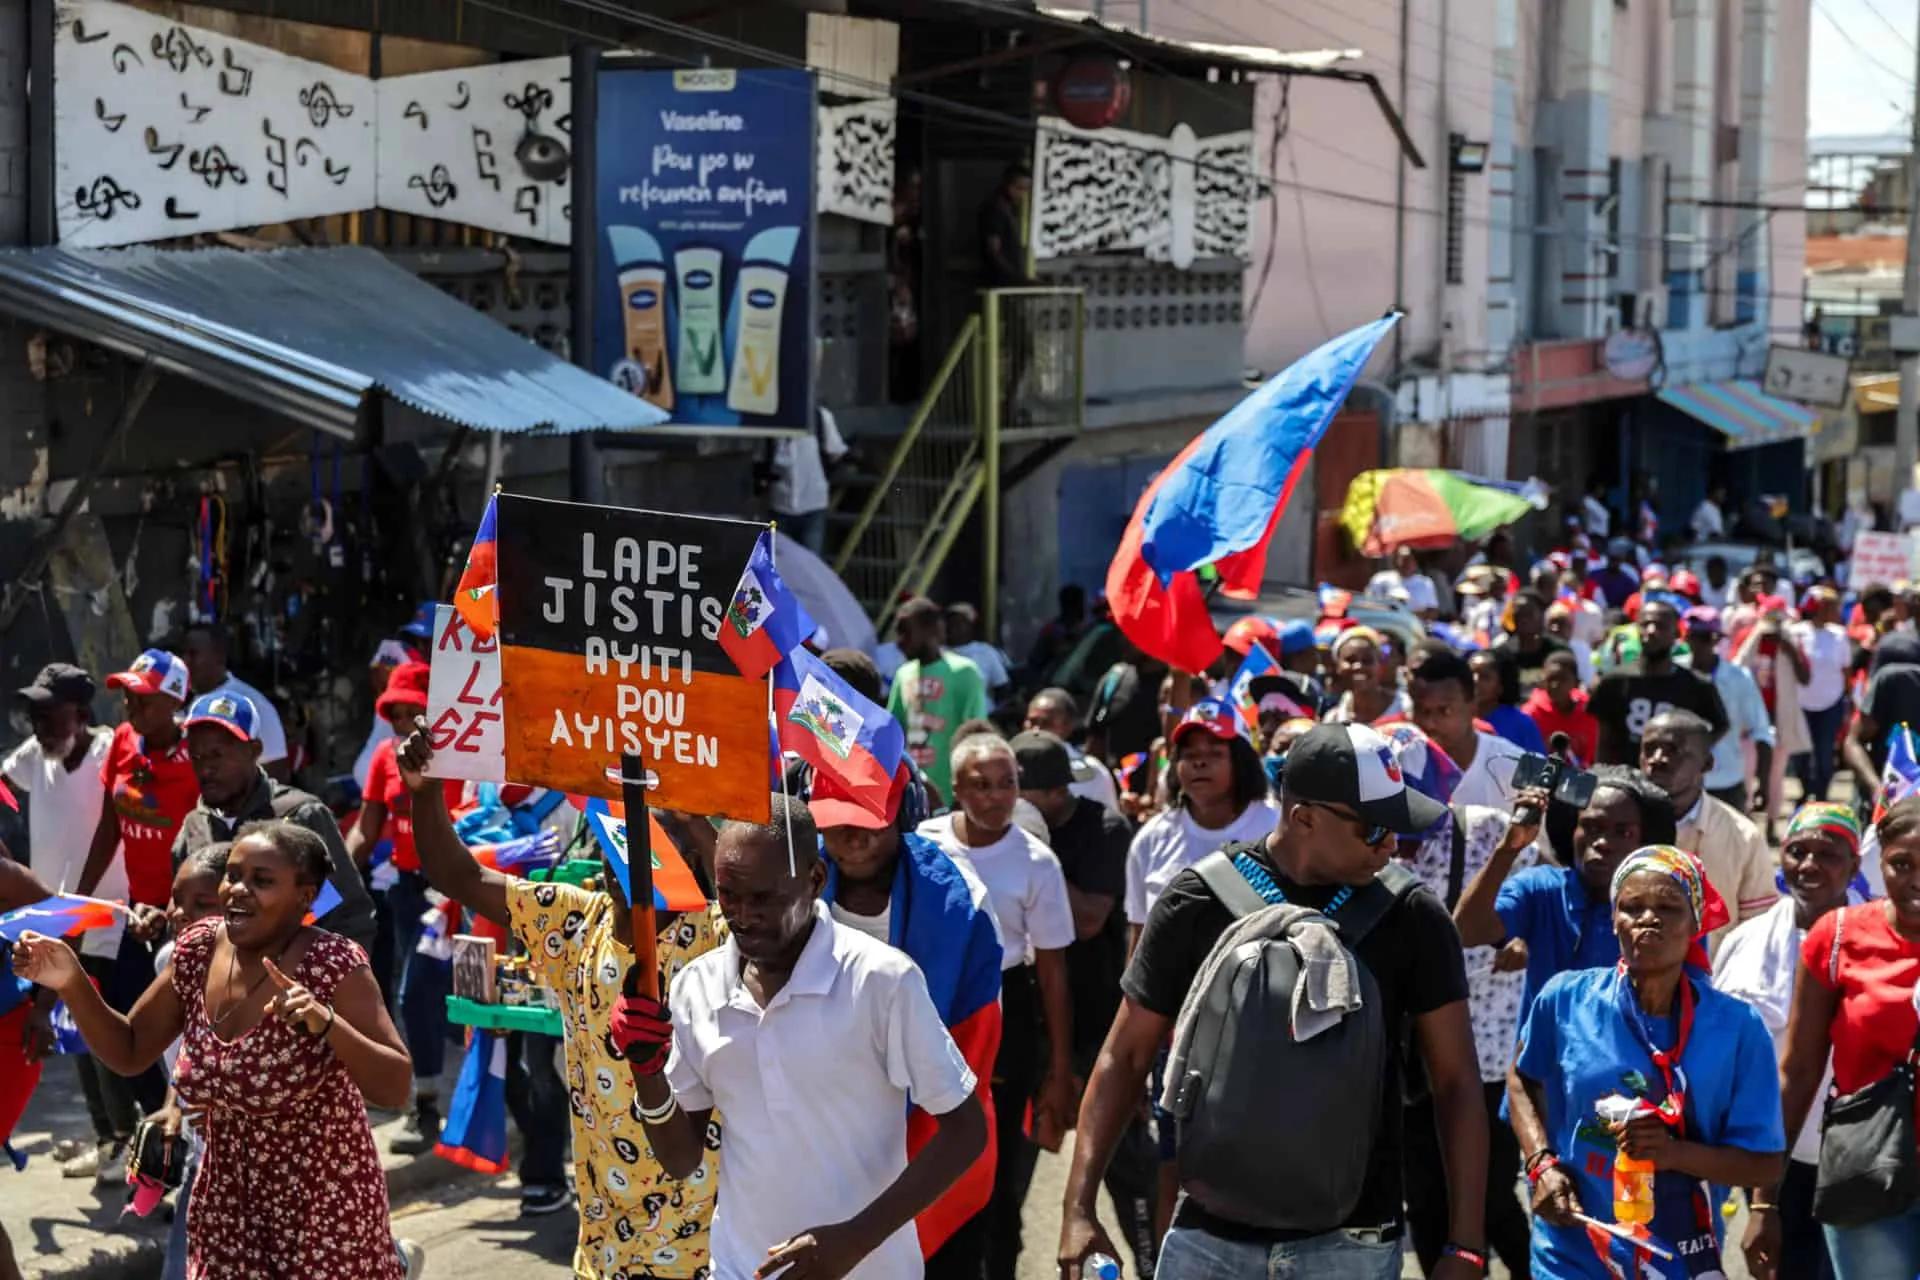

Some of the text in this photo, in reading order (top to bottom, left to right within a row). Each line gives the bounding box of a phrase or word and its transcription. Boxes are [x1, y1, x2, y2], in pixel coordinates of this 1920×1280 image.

[660, 110, 744, 131] Vaseline
[652, 144, 755, 187] Pou po w
[582, 532, 702, 590] LAPE
[542, 576, 722, 641] JISTIS
[585, 636, 693, 686] AYITI
[616, 685, 686, 727] POU
[550, 708, 719, 769] AYISYEN
